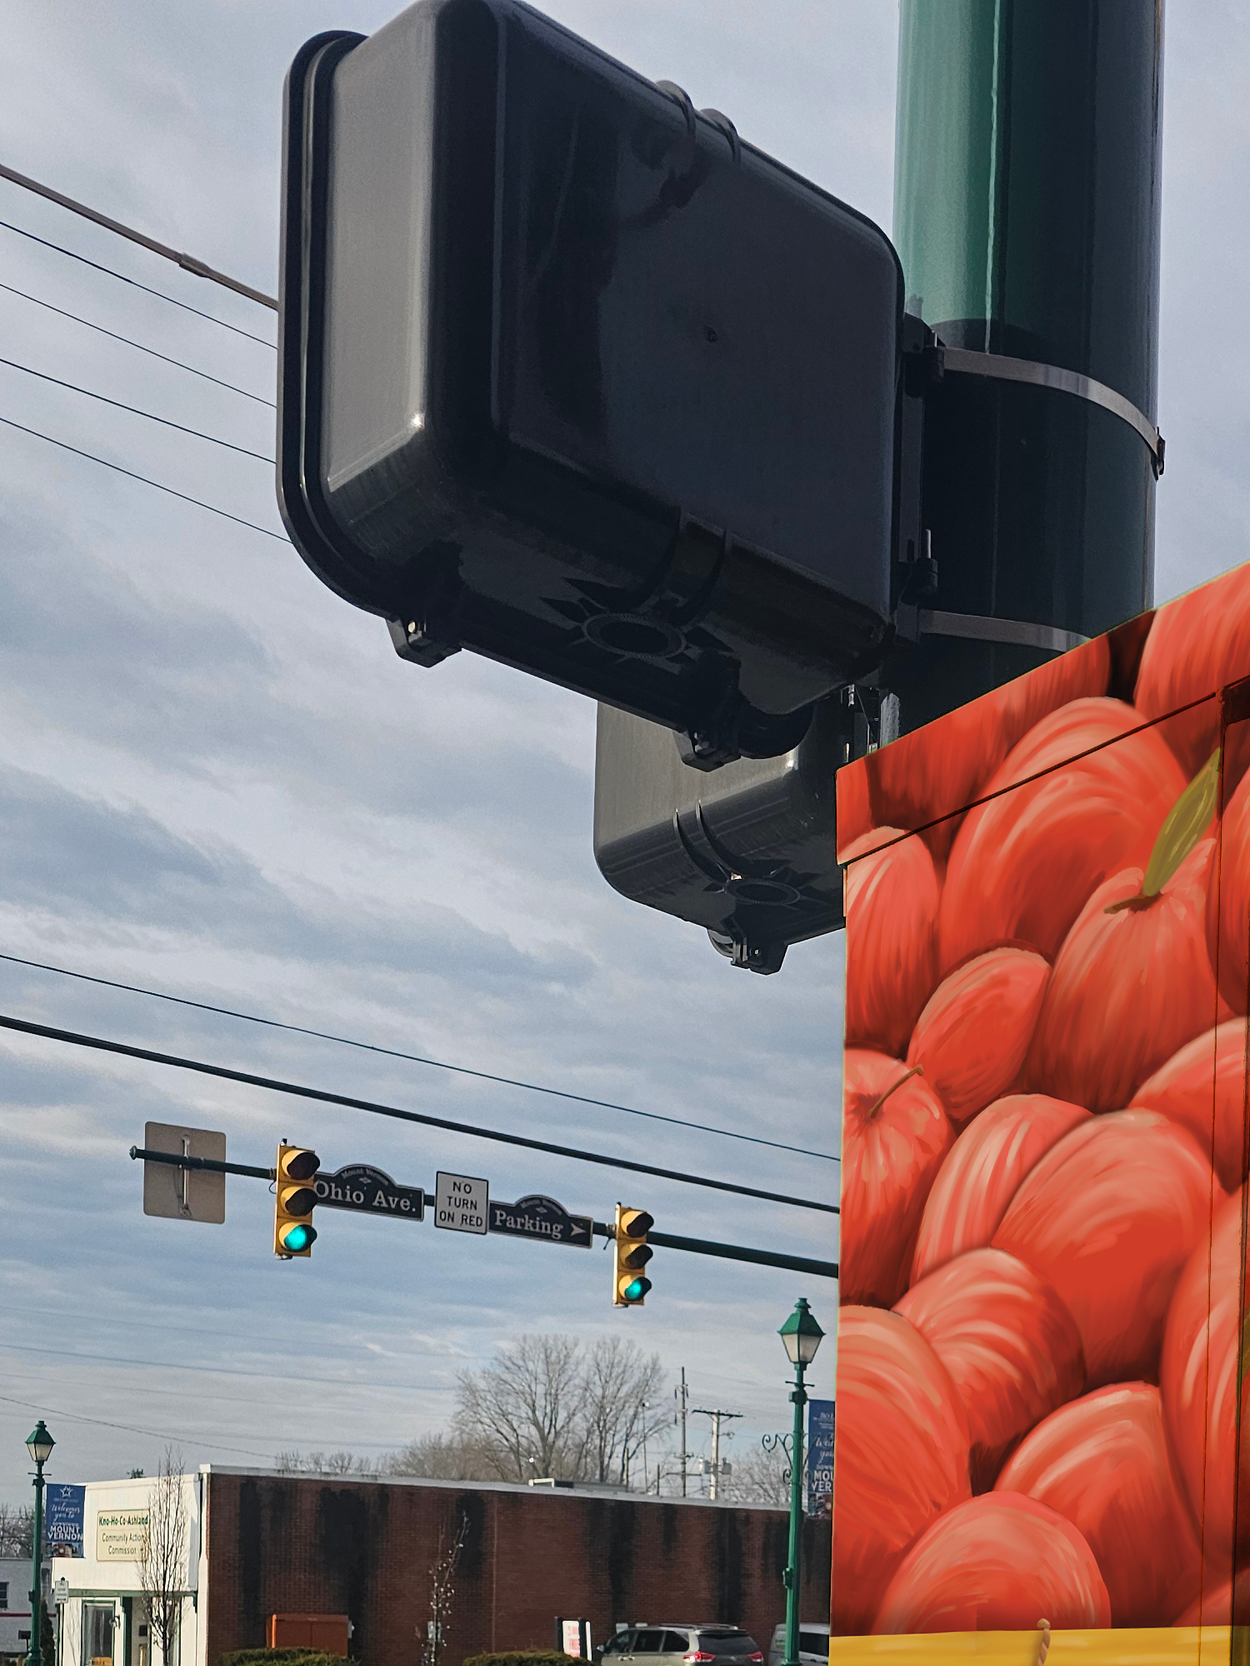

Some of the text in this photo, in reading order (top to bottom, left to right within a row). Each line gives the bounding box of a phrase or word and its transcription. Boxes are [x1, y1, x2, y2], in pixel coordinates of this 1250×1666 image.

[453, 1181, 472, 1194] NO
[314, 1180, 416, 1212] Ohio Ave.
[447, 1196, 478, 1211] TURN
[439, 1210, 483, 1227] ON RED
[494, 1209, 564, 1240] Parking
[50, 1525, 80, 1534] MOUNT
[48, 1532, 83, 1541] VERNON
[101, 1532, 128, 1545] Community
[108, 1545, 137, 1555] Commission
